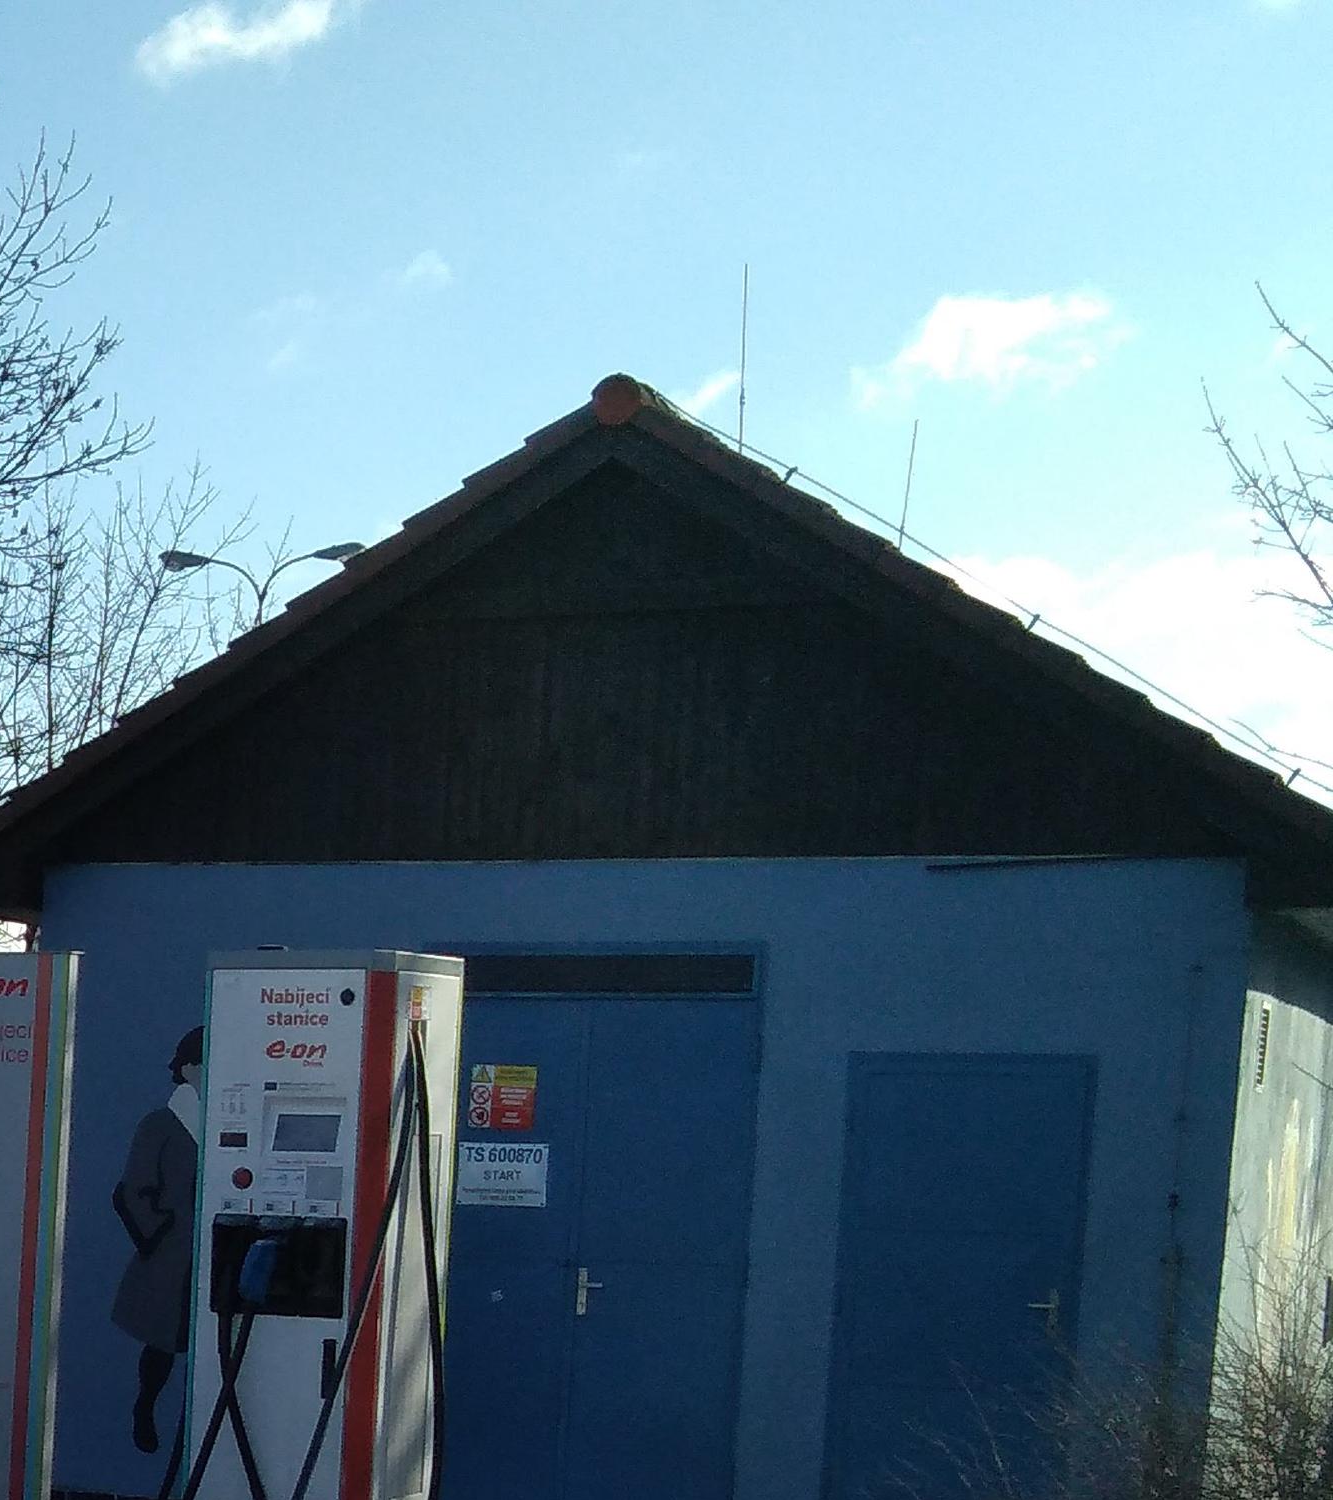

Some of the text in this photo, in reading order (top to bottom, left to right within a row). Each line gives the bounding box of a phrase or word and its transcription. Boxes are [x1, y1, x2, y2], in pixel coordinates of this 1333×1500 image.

[266, 1009, 329, 1027] stanice
[464, 1146, 543, 1165] TS 600870
[483, 1169, 522, 1181] START
